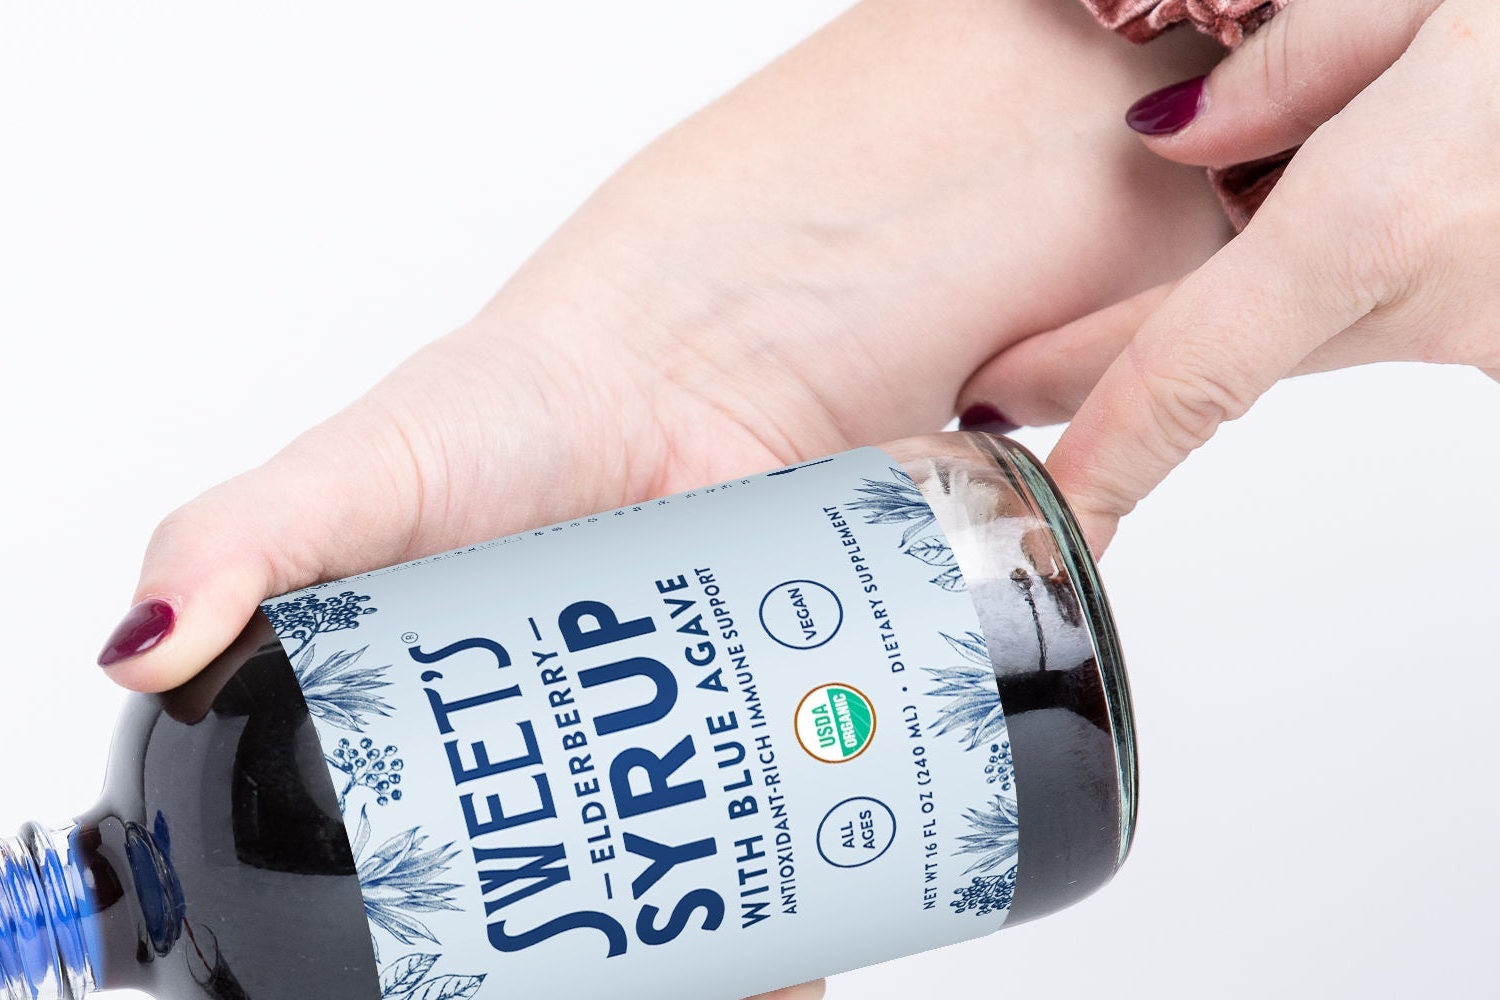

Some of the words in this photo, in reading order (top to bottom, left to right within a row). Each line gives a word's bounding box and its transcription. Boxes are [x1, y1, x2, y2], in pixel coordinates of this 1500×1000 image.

[822, 505, 879, 596] SUPPLEMENT
[694, 567, 739, 640] SUPPORT
[787, 587, 818, 641] VEGAN
[654, 573, 729, 693] AGAVE
[869, 597, 906, 674] DIETARY
[727, 644, 767, 728] IMMUNE
[811, 703, 836, 749] USDA
[832, 692, 858, 749] ORGANIC
[902, 704, 922, 738] ML)
[532, 650, 616, 864] ELDERBERRY
[557, 600, 726, 946] SYRUP
[705, 710, 761, 820] BLUE
[912, 746, 931, 786] (240
[407, 636, 628, 959] SWEET'S
[754, 735, 798, 914] ANTIOXIDANT-RICH
[919, 791, 935, 814] OZ
[840, 820, 855, 849] ALL
[859, 809, 876, 850] AGES
[923, 818, 937, 838] FL
[925, 842, 938, 858] 16
[733, 834, 774, 929] WITH
[923, 887, 938, 910] NET
[924, 863, 938, 883] WT
